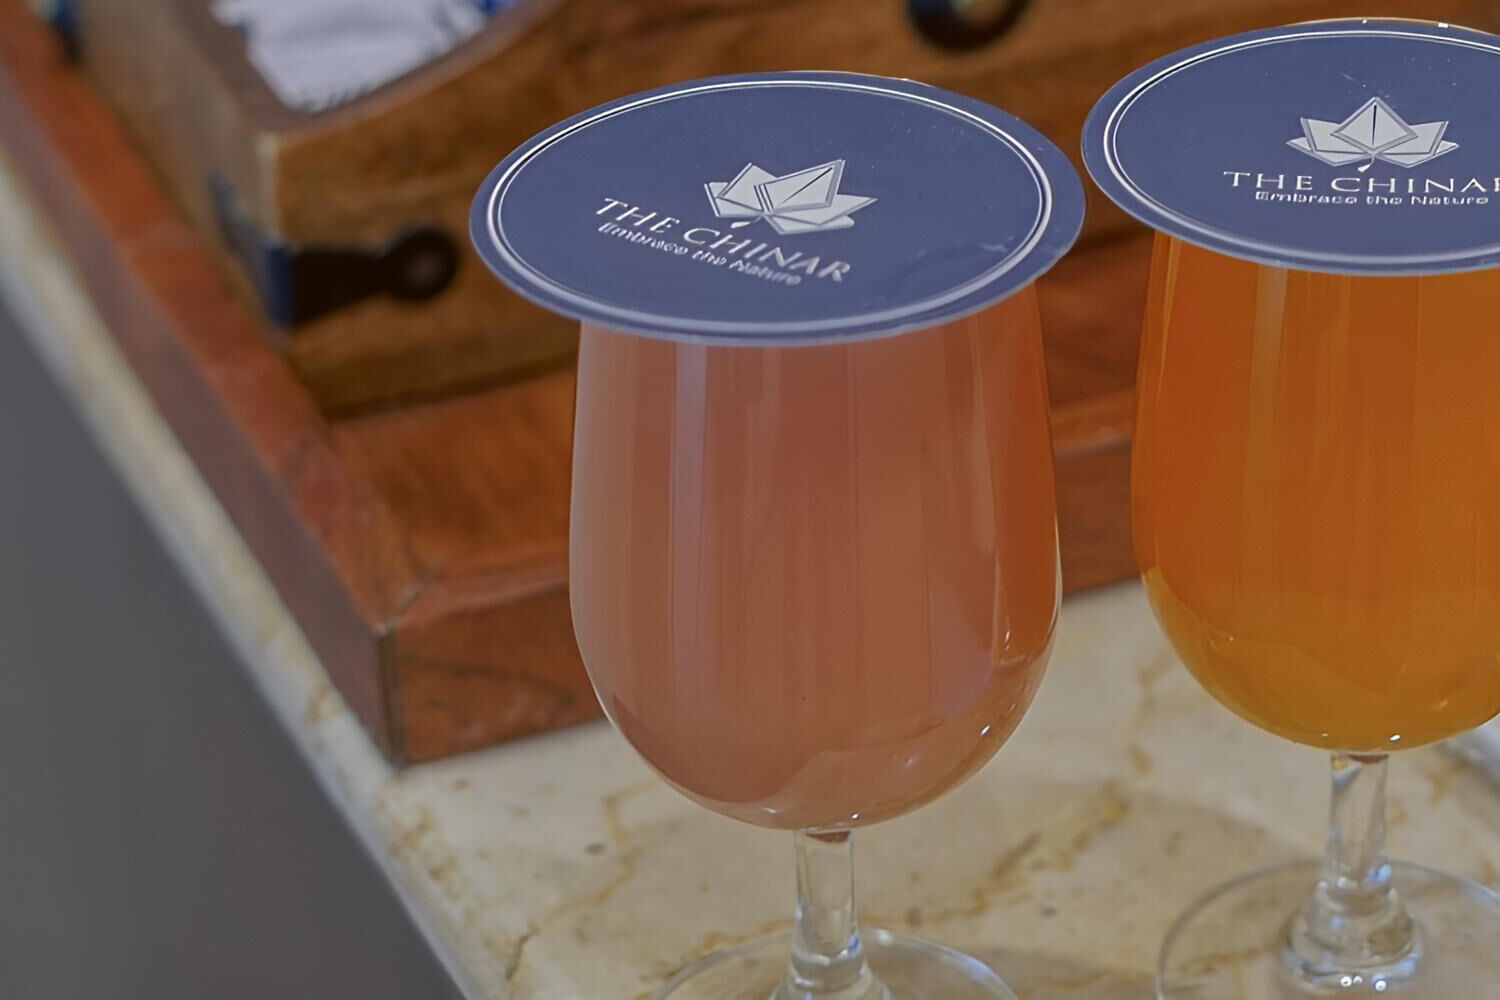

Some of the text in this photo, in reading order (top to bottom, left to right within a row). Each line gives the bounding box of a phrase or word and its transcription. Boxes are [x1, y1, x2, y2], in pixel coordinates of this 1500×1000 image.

[1223, 171, 1313, 191] THE
[1255, 190, 1489, 206] Embrace the Nature
[596, 198, 850, 282] THE CHINAR
